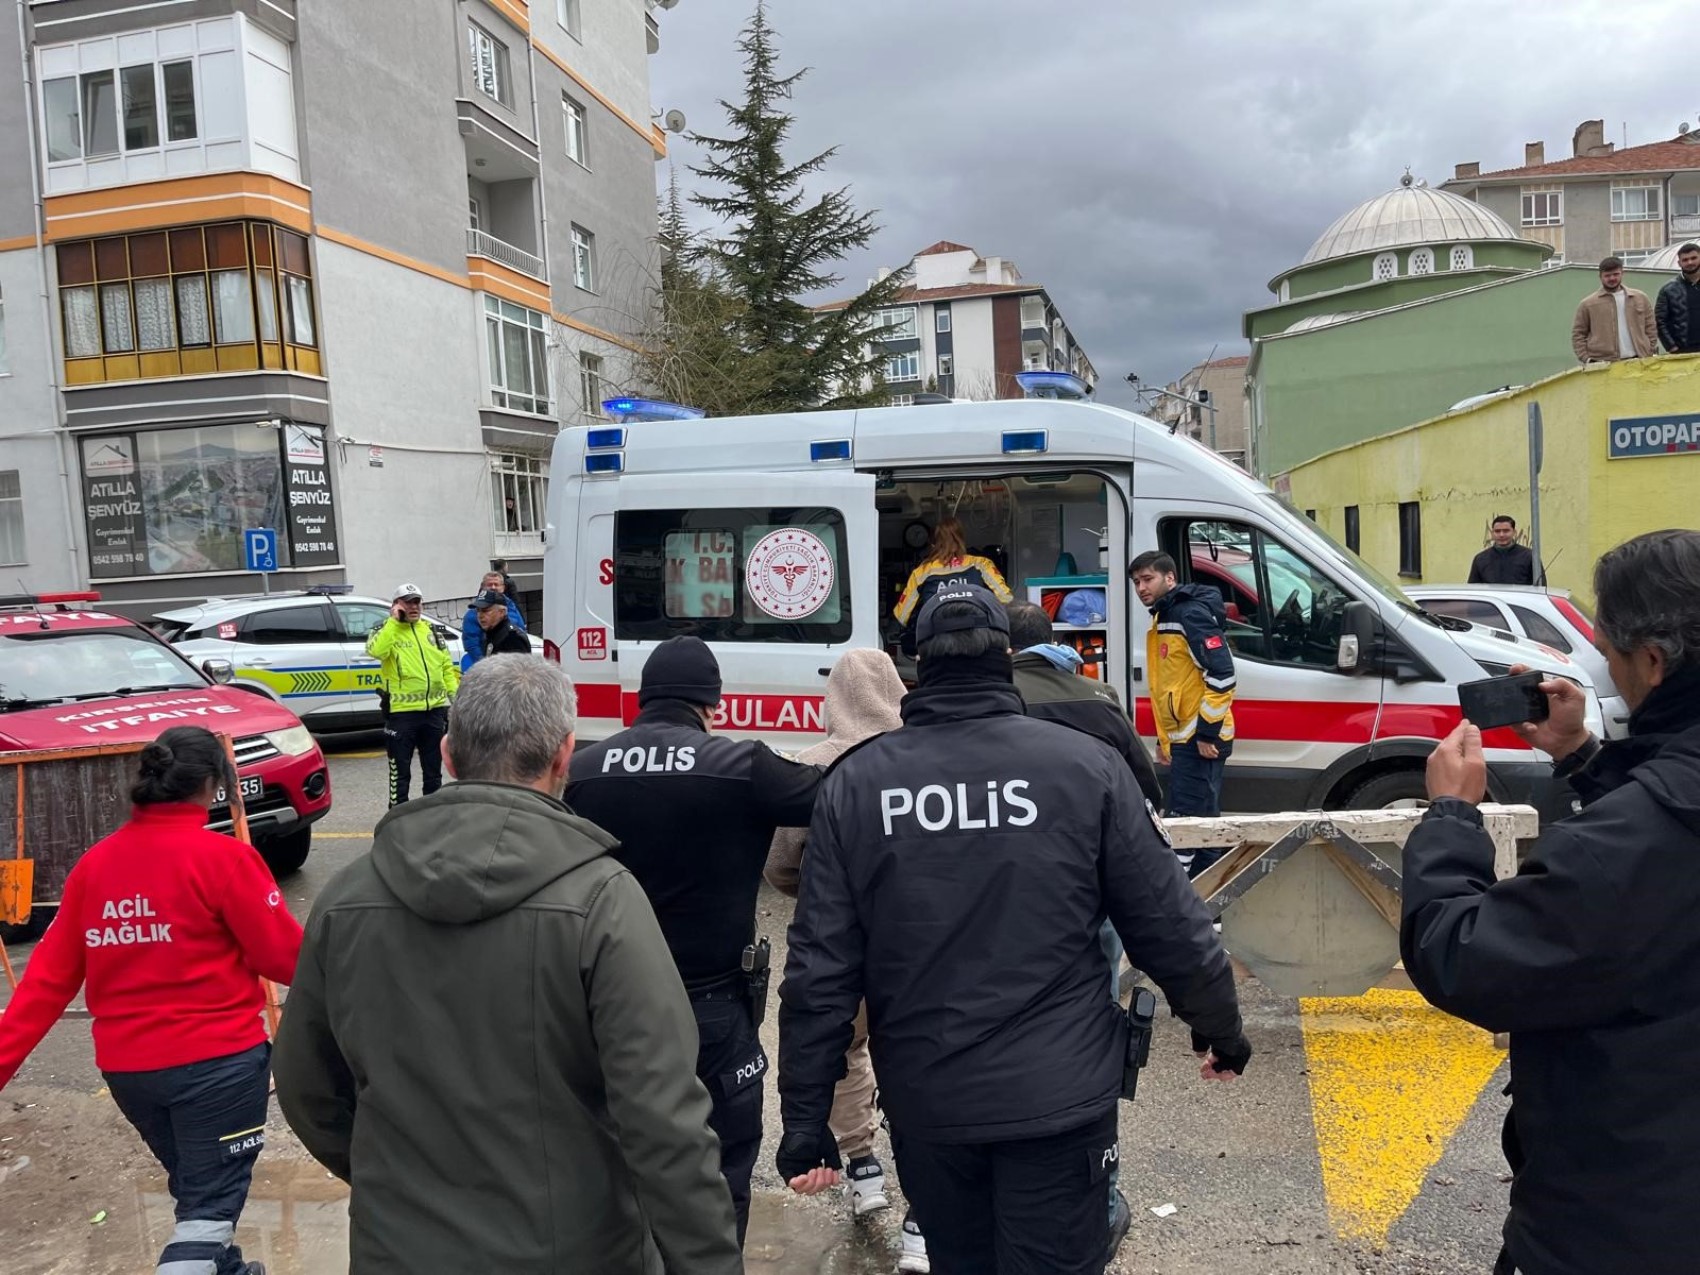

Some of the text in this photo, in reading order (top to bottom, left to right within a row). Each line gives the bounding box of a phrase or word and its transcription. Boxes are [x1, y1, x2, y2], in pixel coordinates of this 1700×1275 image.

[289, 489, 331, 507] ŞENYÜZ
[87, 500, 142, 520] ŞENYÜZ
[251, 533, 270, 567] P
[581, 631, 602, 647] 112
[101, 894, 156, 920] ACİL
[85, 921, 172, 948] SAĞLIK
[229, 1142, 241, 1154] 112
